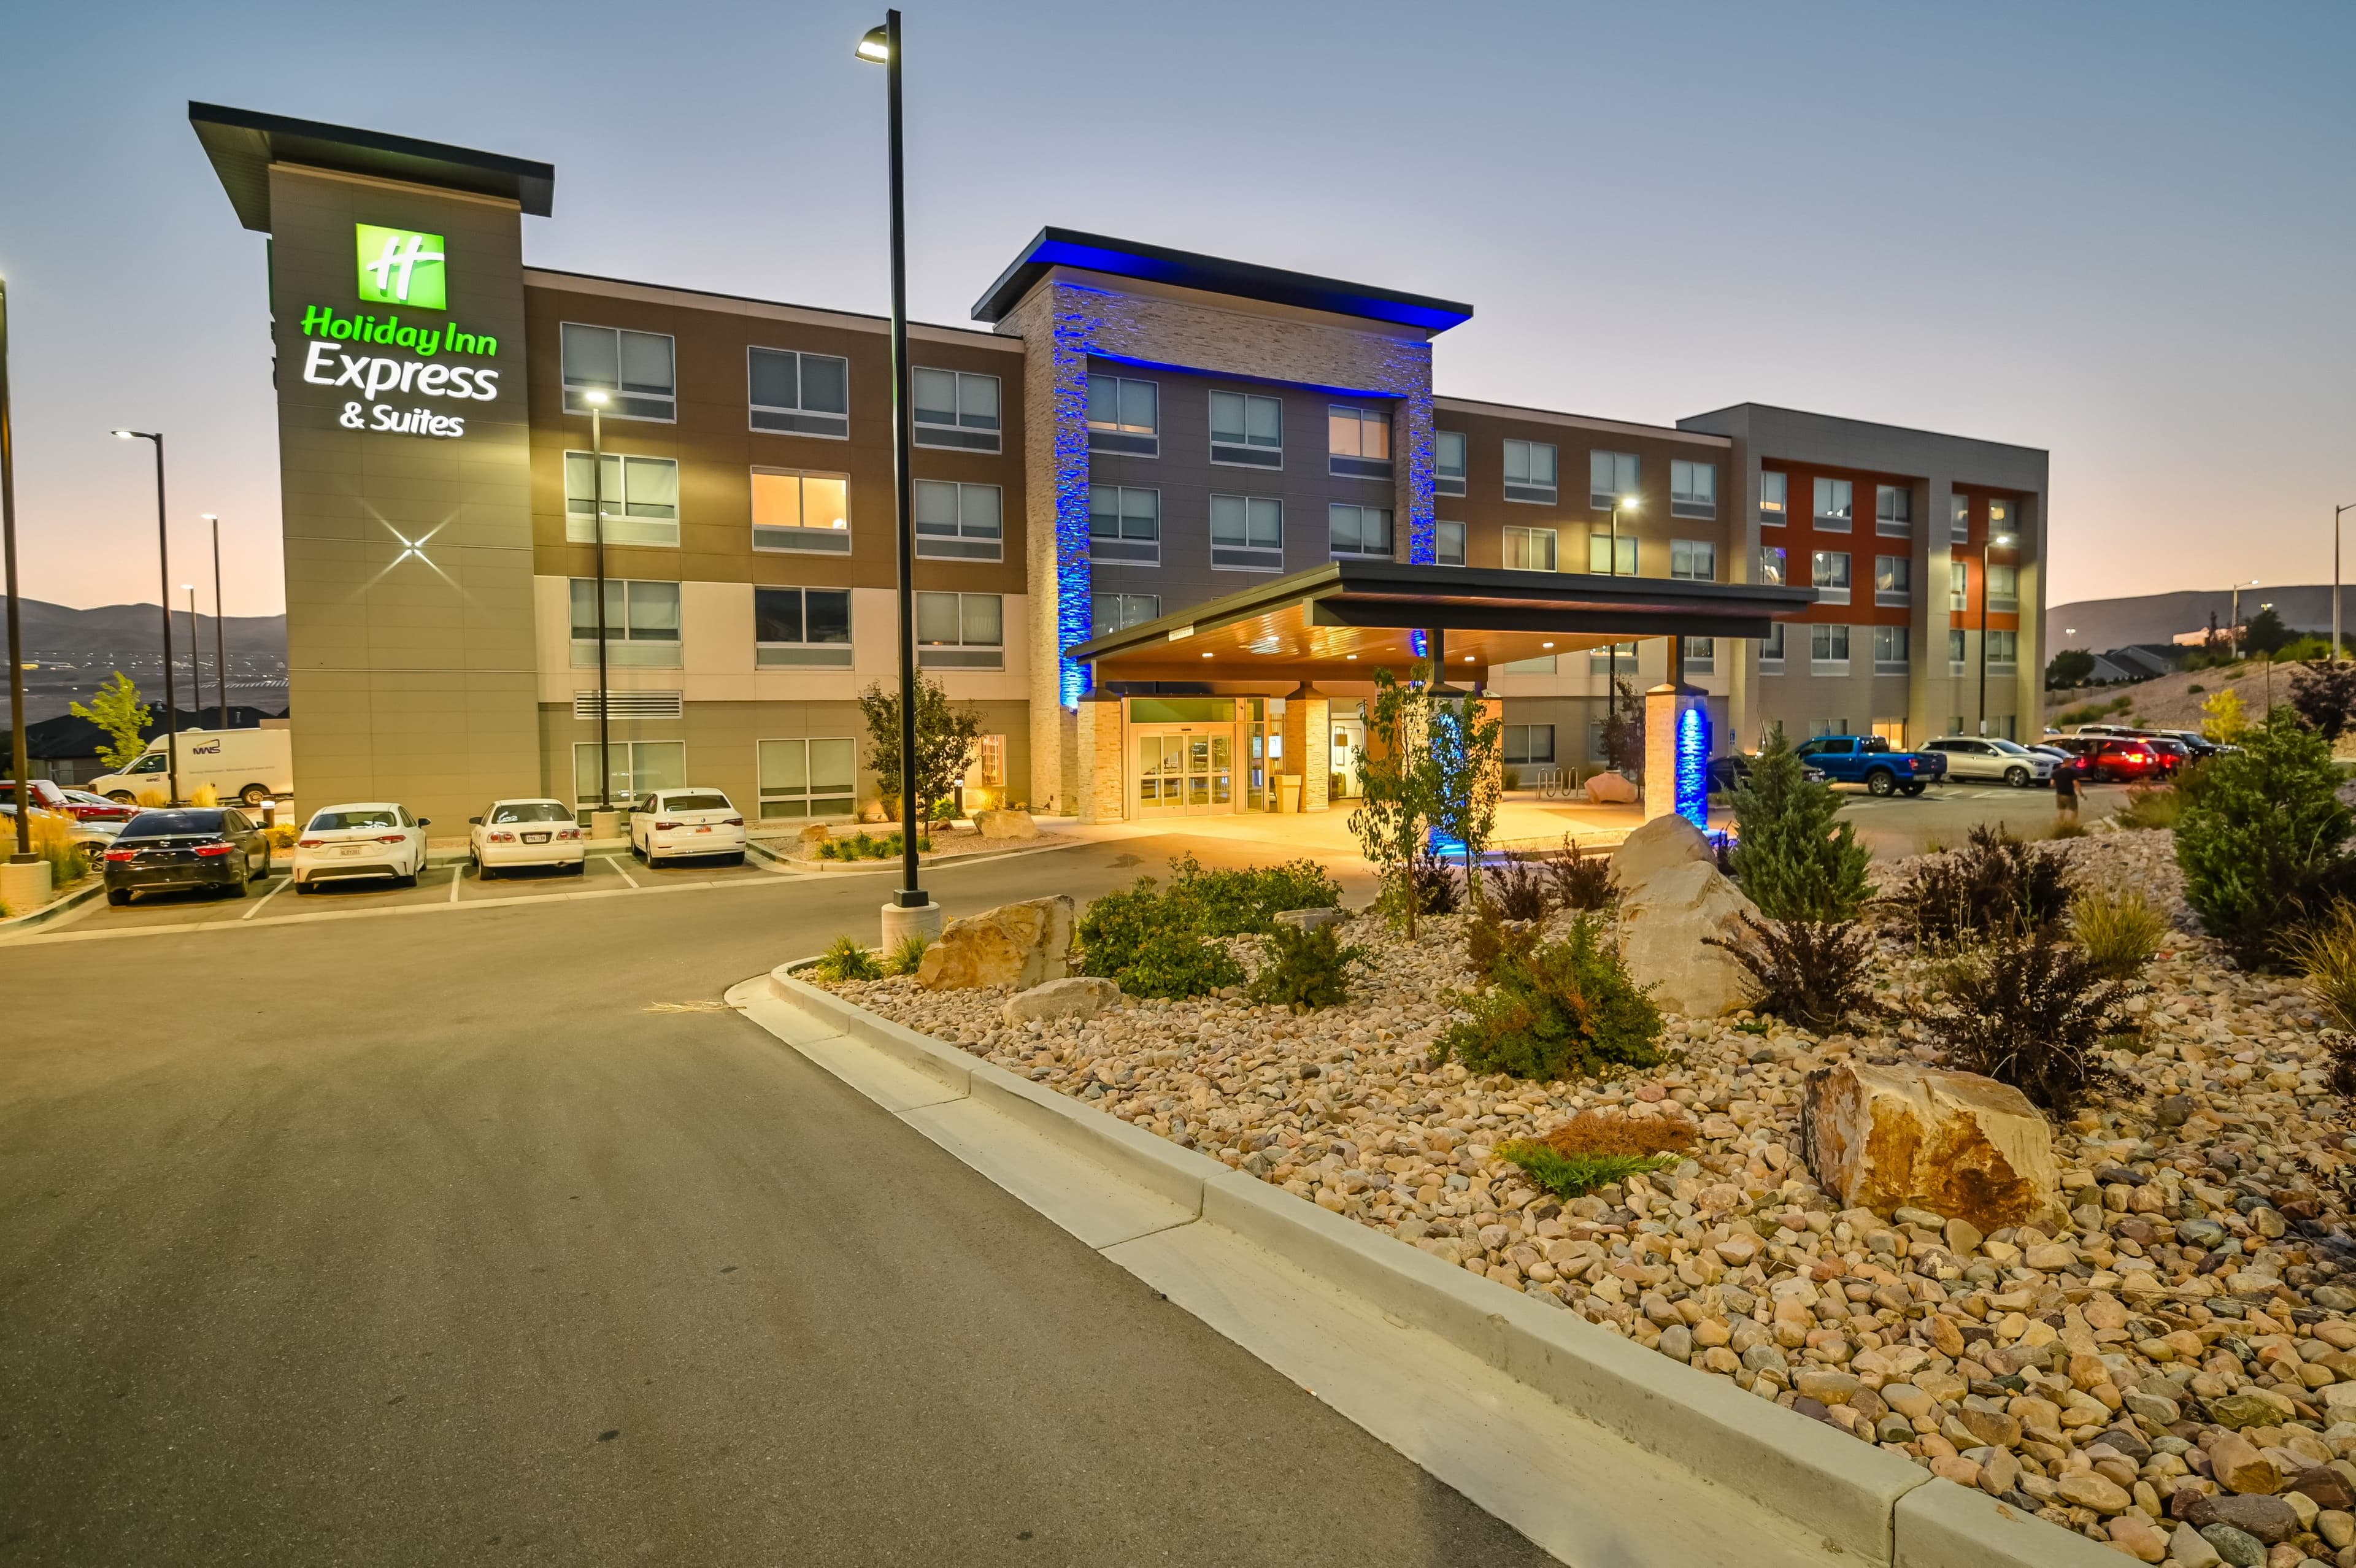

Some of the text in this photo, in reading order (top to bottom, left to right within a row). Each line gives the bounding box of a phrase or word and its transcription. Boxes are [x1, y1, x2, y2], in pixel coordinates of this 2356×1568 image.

[300, 305, 498, 356] Holiday Inn
[303, 340, 499, 401] Express
[339, 402, 464, 437] & Suites
